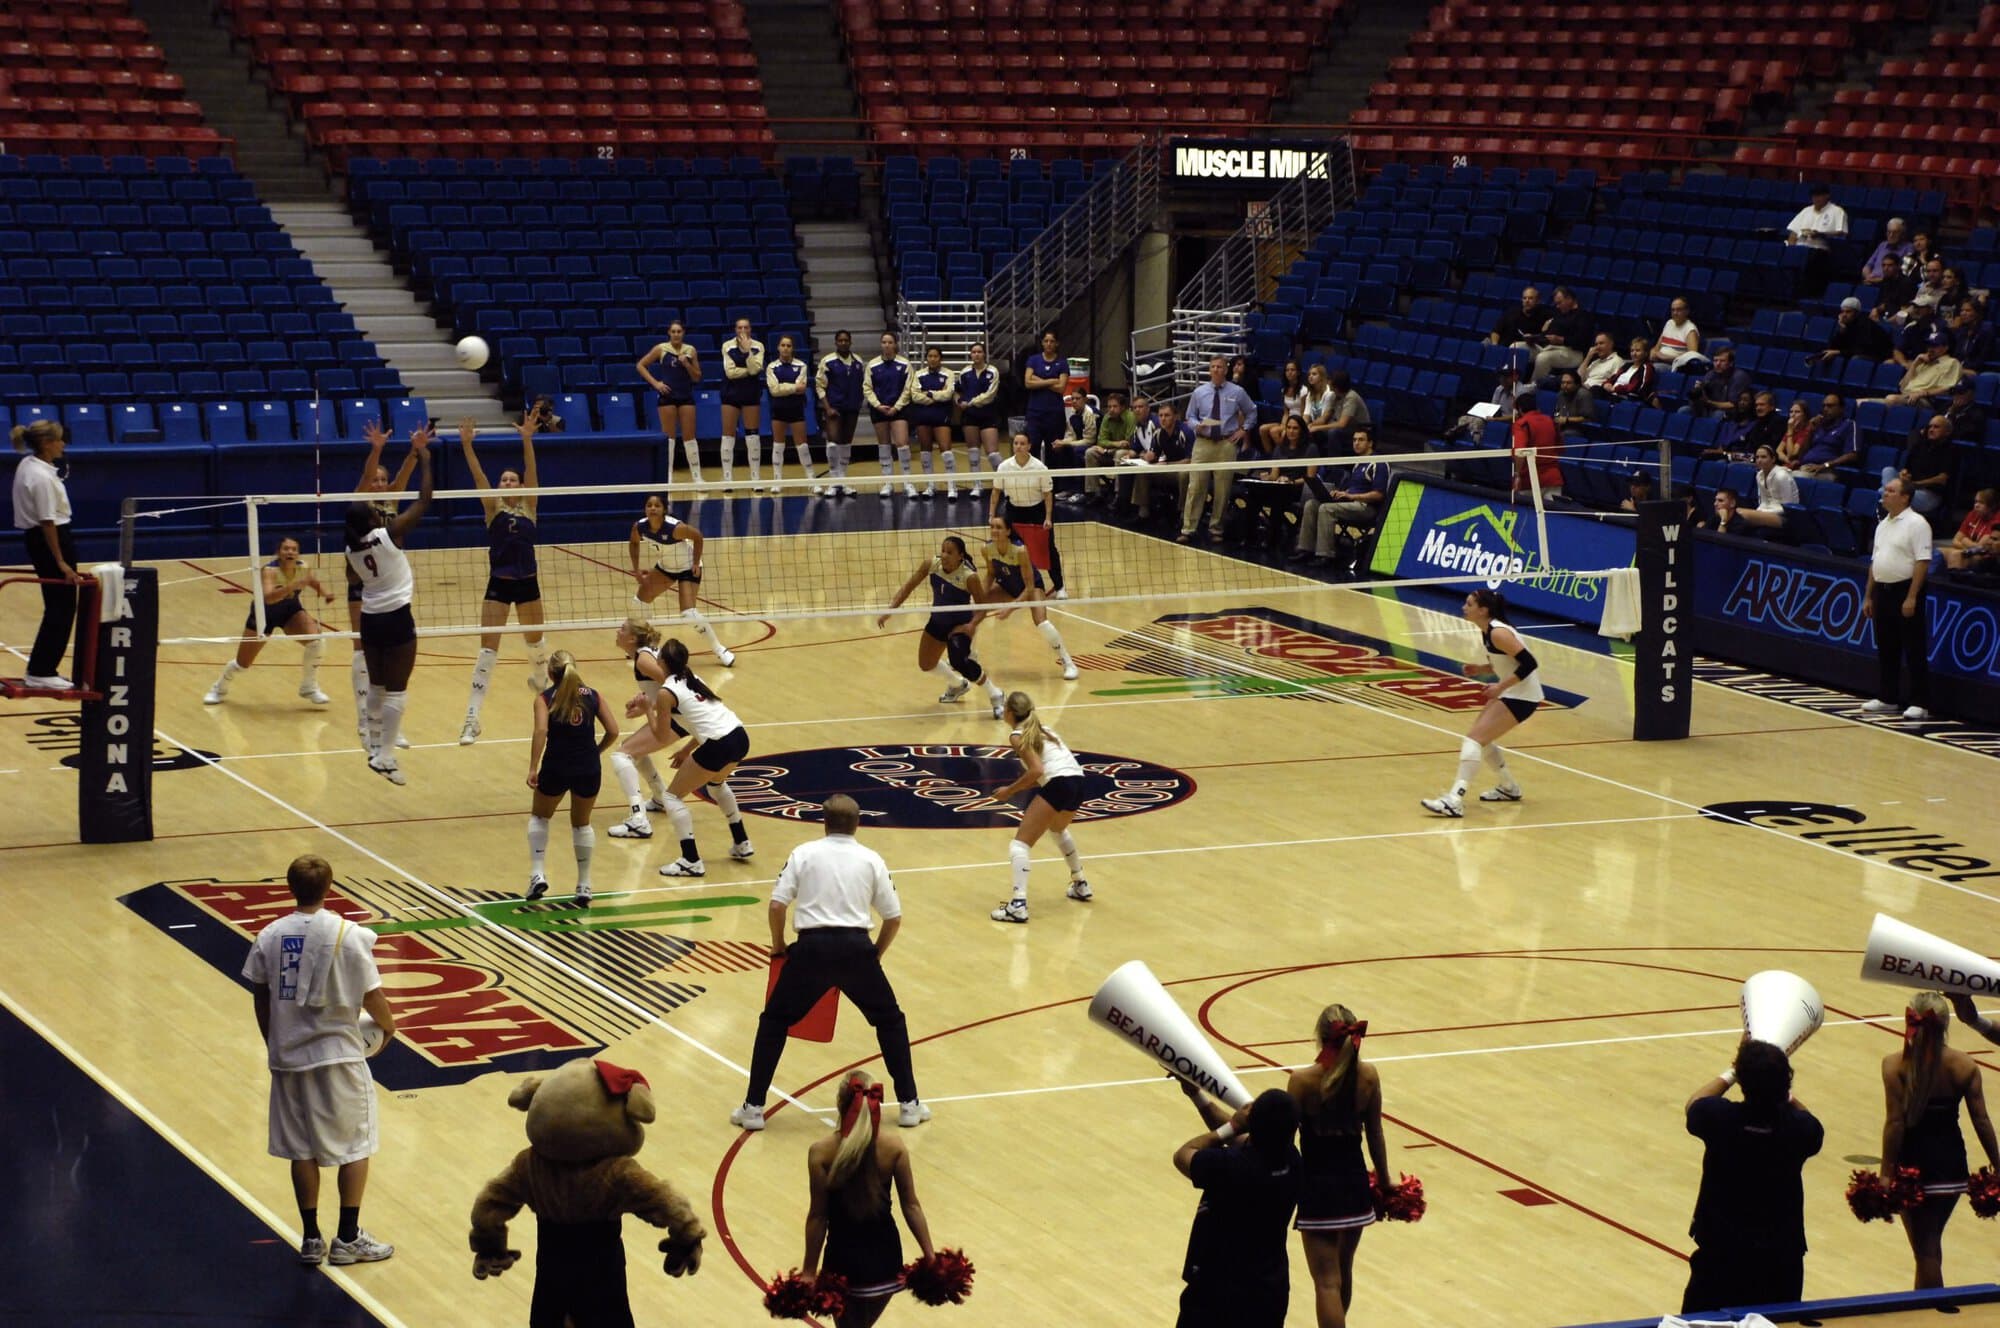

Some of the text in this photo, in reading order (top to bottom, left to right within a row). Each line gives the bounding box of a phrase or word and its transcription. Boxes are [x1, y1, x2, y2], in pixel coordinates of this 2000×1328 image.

[597, 146, 614, 160] 22
[1010, 148, 1026, 160] 23
[1176, 148, 1328, 179] MUSCLE MILK
[1452, 155, 1467, 168] 24
[364, 554, 378, 577] 9
[1417, 529, 1603, 602] Meritage Homes
[1661, 524, 1681, 703] WILDCATS
[1722, 559, 1879, 650] ARIZON
[105, 597, 134, 793] ARIZONA
[850, 746, 1035, 760] LUT
[1106, 1006, 1229, 1099] BEARDOWN
